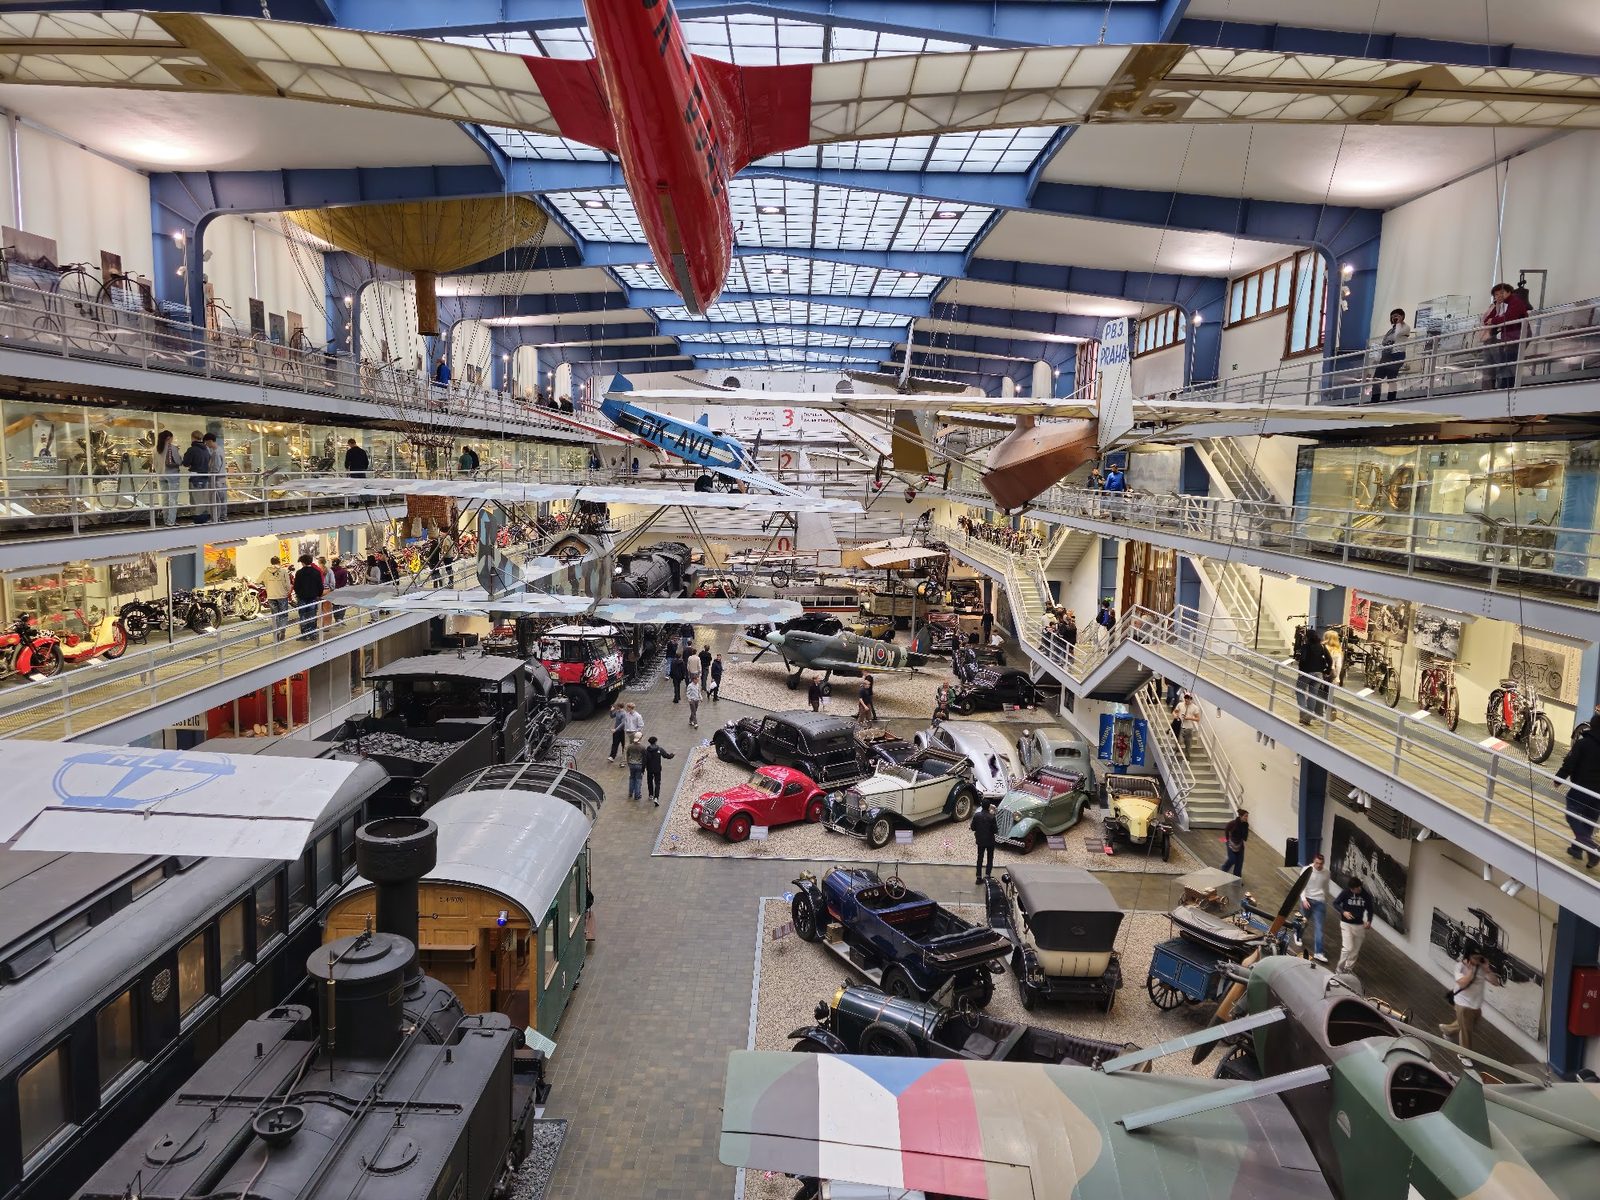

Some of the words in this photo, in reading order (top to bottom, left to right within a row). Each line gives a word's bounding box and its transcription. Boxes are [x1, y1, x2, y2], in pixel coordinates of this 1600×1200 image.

[1100, 344, 1128, 366] PRAHA
[782, 409, 795, 427] 3
[781, 452, 792, 469] 2
